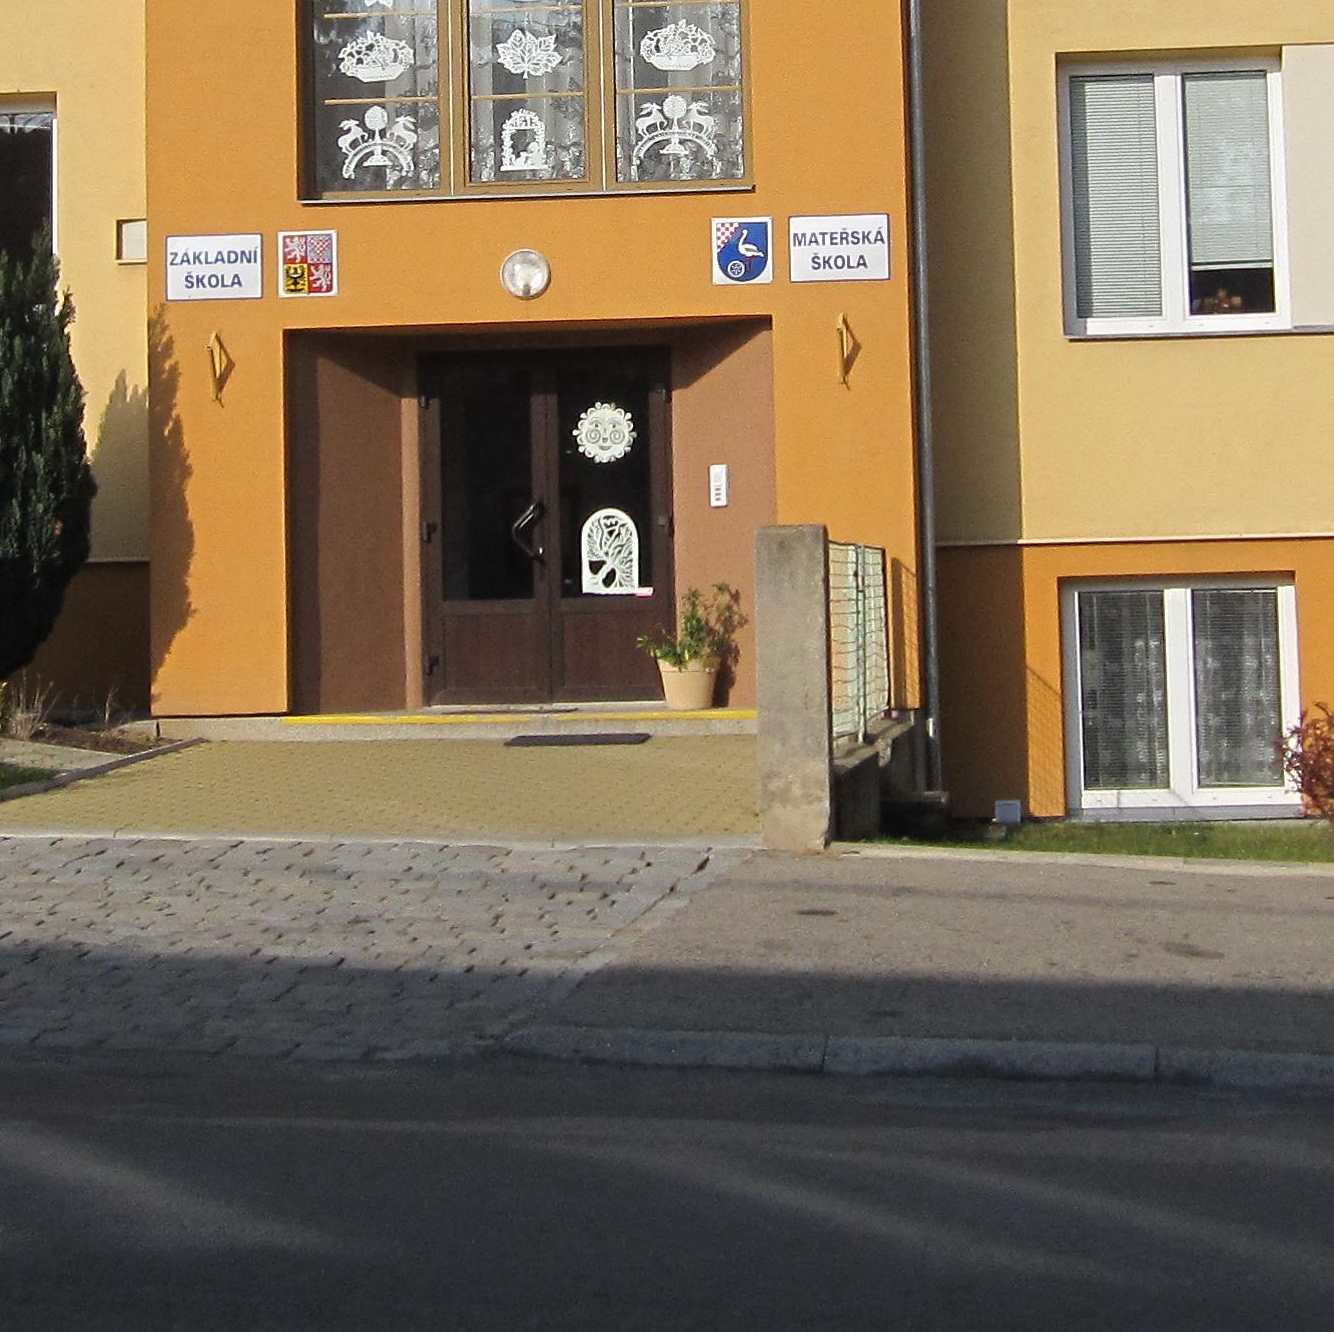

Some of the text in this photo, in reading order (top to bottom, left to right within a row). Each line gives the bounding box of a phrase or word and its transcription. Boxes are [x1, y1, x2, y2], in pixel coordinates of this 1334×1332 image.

[792, 226, 885, 247] MATEŘSKÁ
[169, 246, 258, 266] ZÁKLADNÍ
[811, 252, 868, 270] ŠKOLA
[184, 270, 243, 289] ŠKOLA
